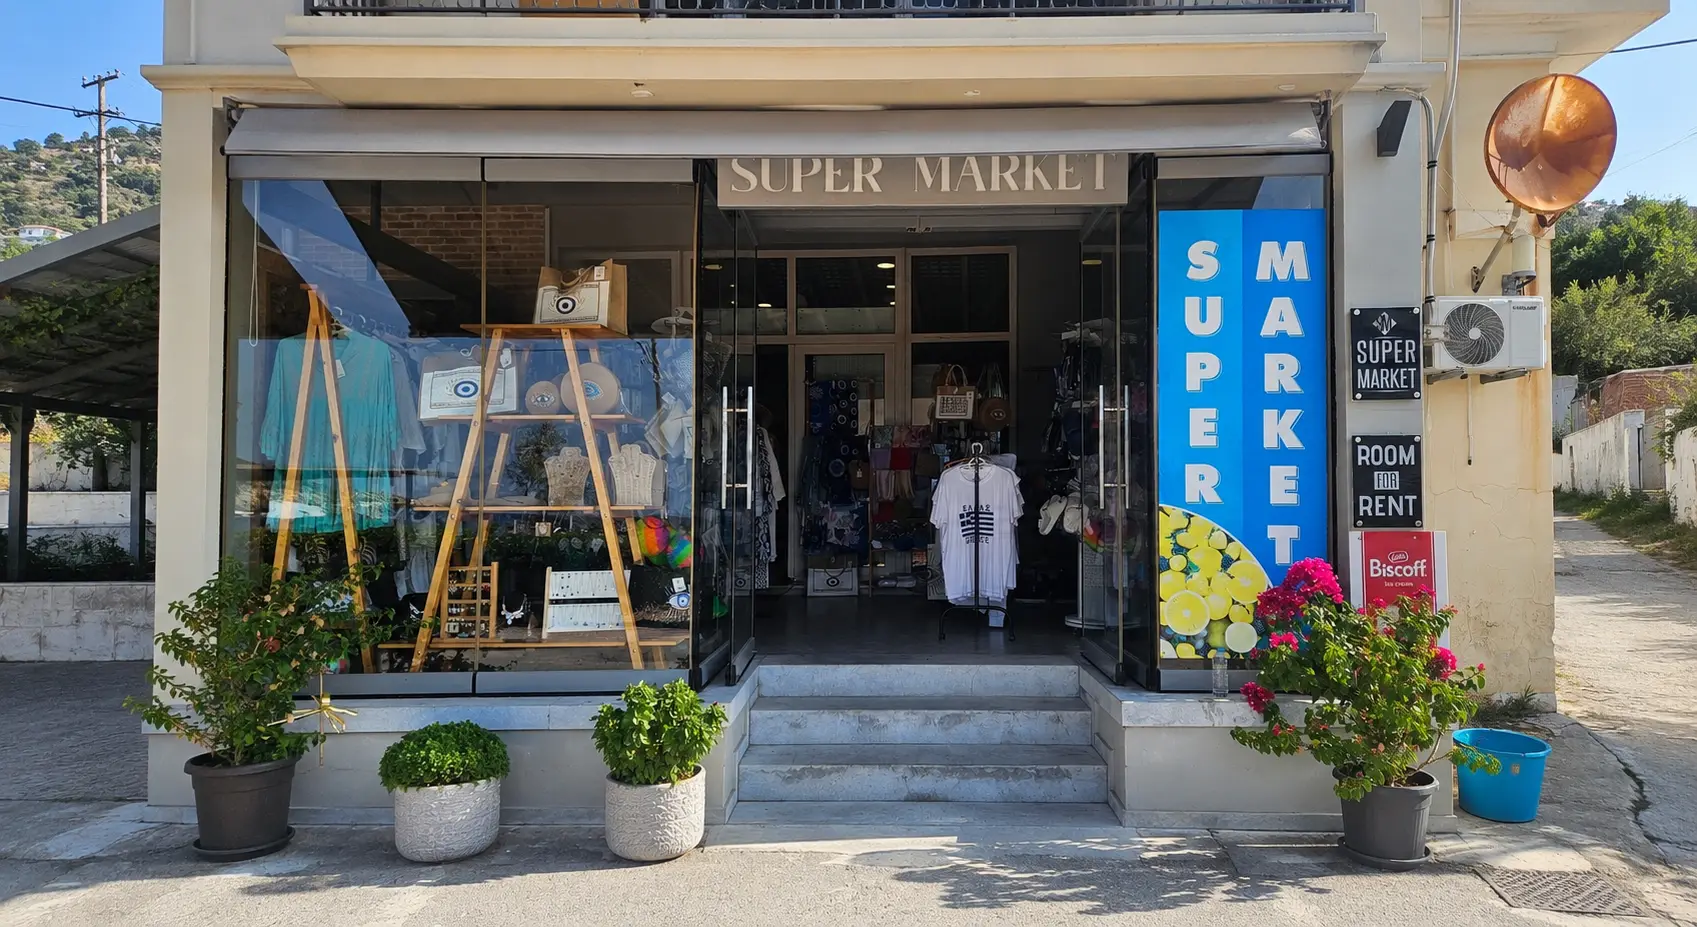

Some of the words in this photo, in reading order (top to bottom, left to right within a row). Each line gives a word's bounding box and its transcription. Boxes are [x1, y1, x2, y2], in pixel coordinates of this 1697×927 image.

[731, 157, 883, 193] SUPER
[914, 153, 1117, 192] MARKET
[1356, 339, 1416, 364] SUPER
[1184, 240, 1225, 505] SUPER
[1357, 367, 1417, 389] MARKET
[1255, 241, 1312, 567] MARKET
[1357, 444, 1415, 466] ROOM
[1377, 472, 1397, 489] FOR
[1359, 495, 1417, 516] RENT
[1369, 558, 1427, 577] Biscoff
